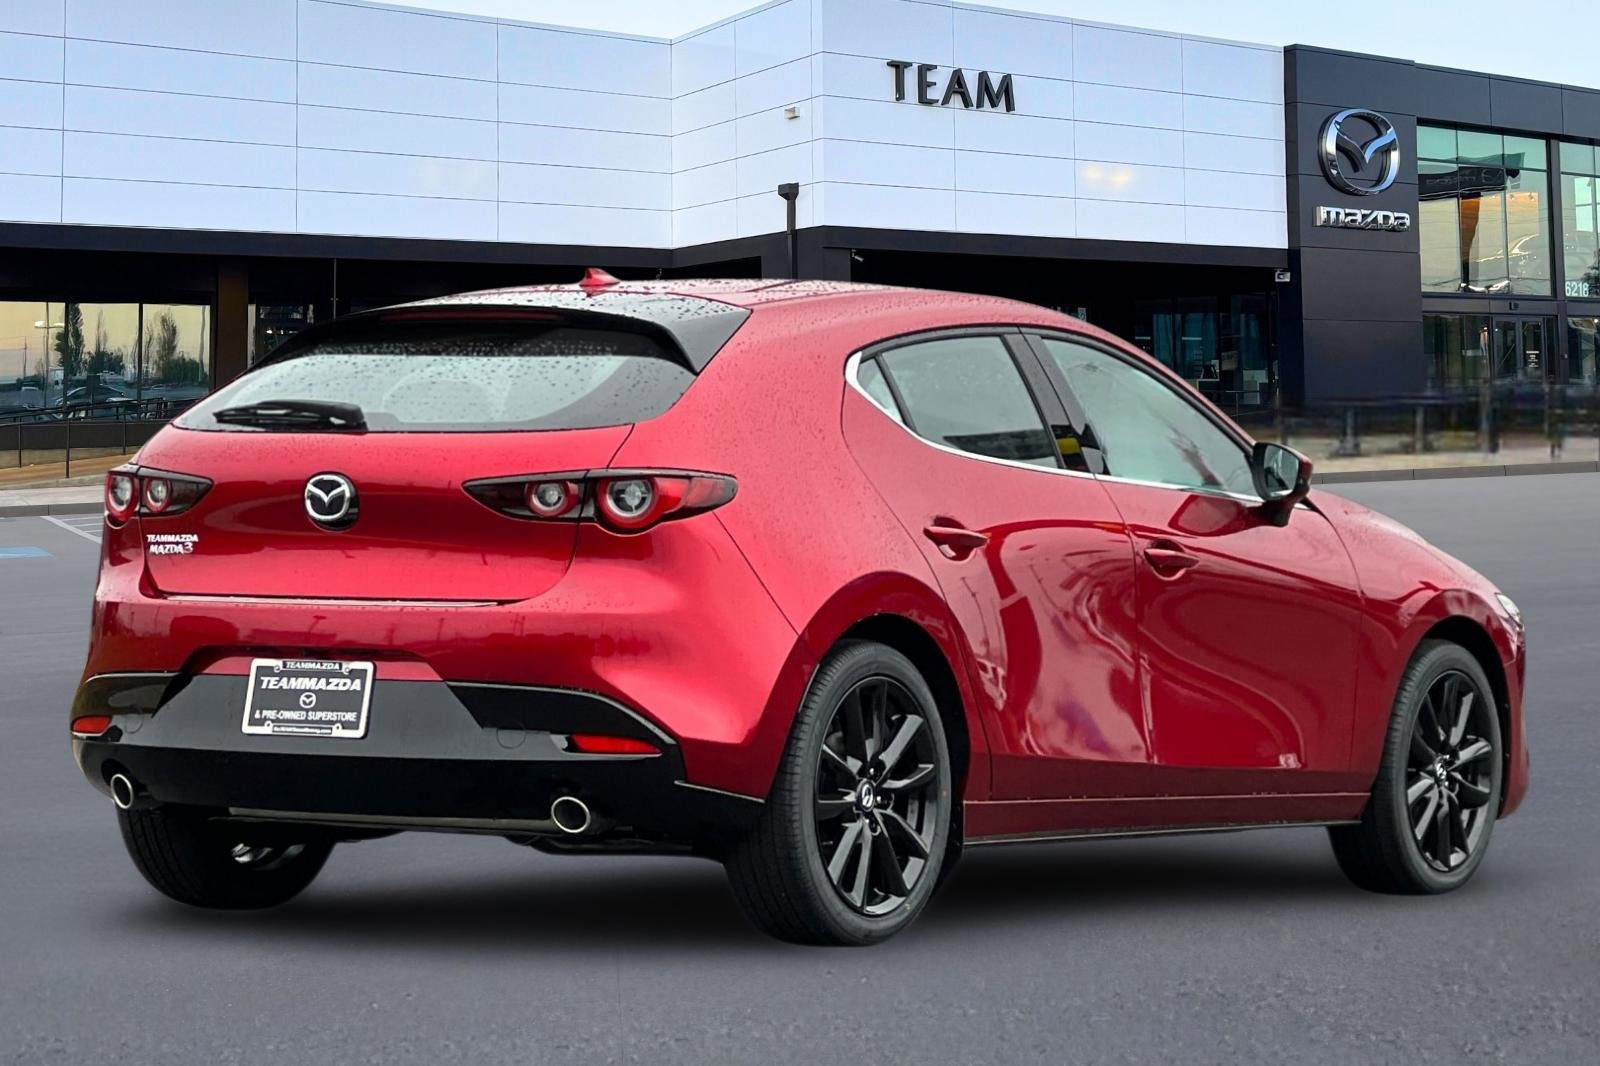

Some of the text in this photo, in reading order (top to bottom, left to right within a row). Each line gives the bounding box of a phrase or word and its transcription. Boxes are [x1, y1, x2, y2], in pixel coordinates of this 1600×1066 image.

[886, 60, 1016, 112] TEAM
[1313, 206, 1411, 232] mazda
[1565, 280, 1589, 297] 6218
[146, 534, 199, 543] TEAMMAZDA
[285, 661, 341, 670] TEAMMAZDA
[260, 676, 362, 691] TEAMMAZDA
[254, 709, 358, 722] & PRE-OWNED SUPERSTORE
